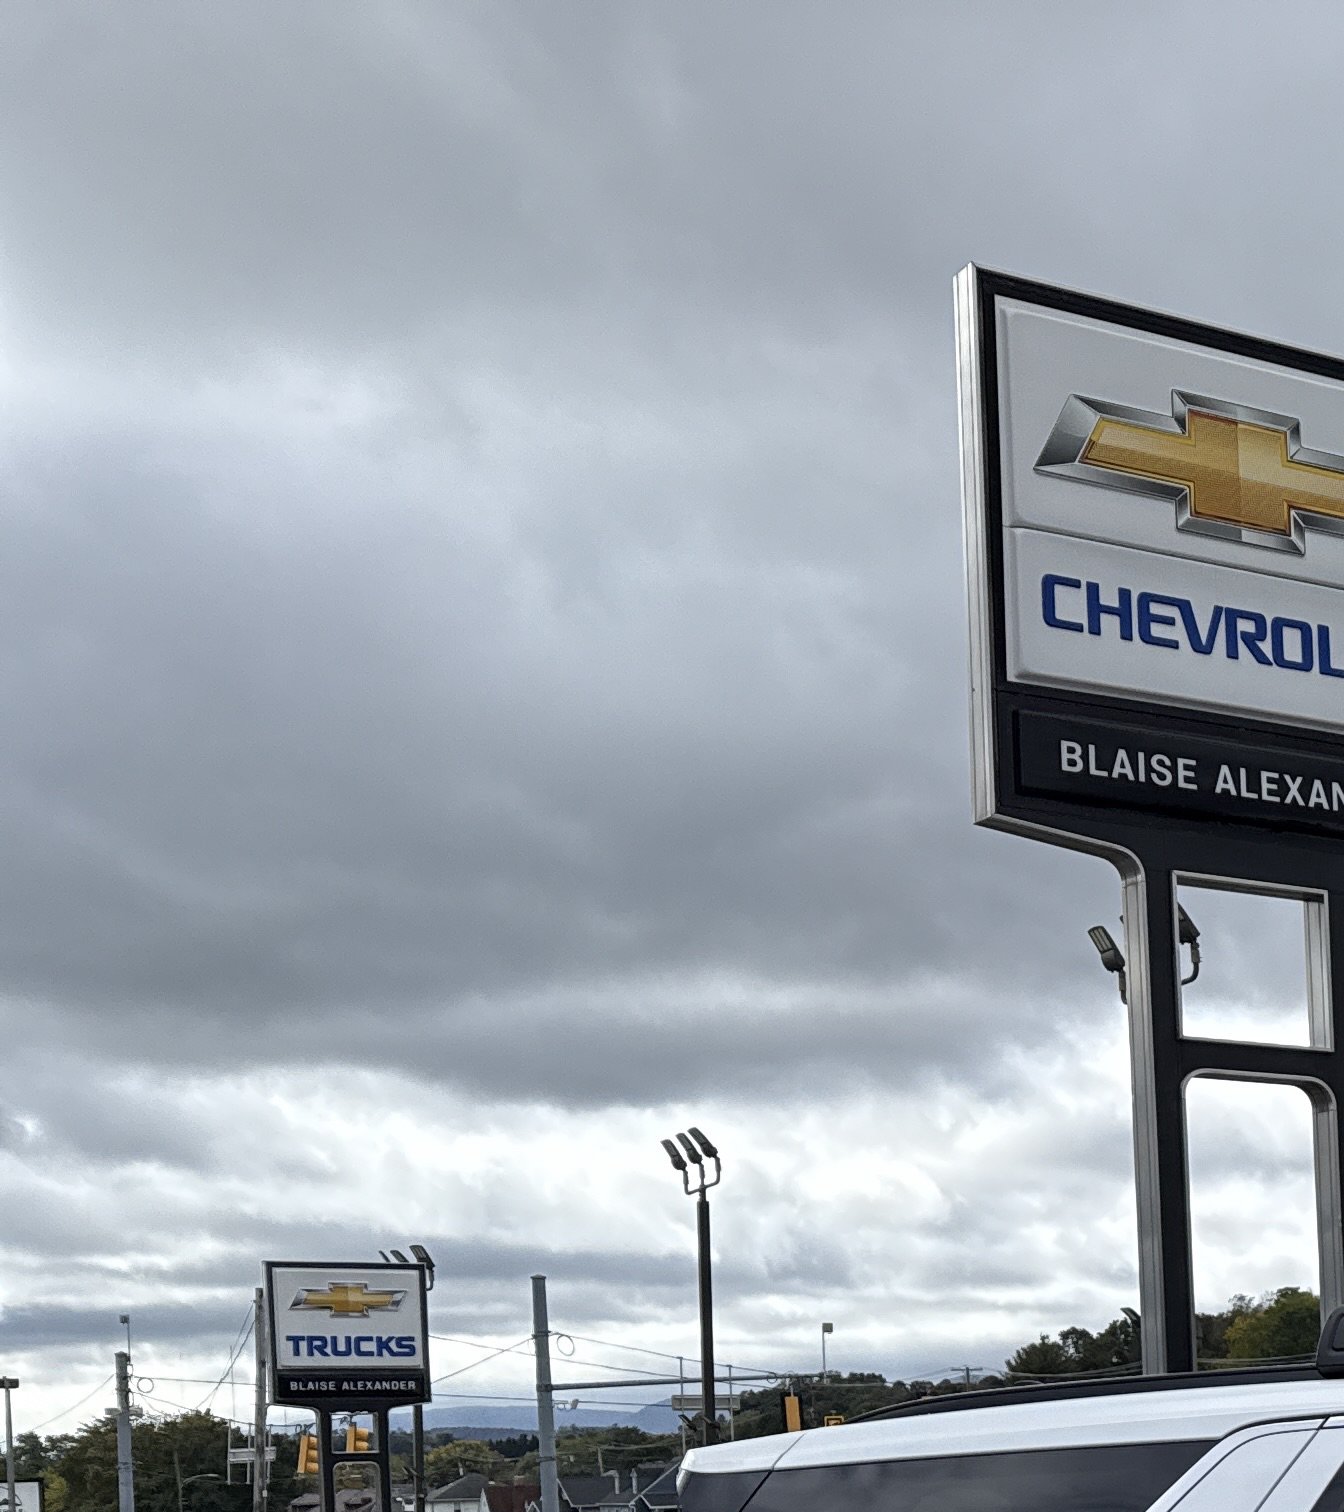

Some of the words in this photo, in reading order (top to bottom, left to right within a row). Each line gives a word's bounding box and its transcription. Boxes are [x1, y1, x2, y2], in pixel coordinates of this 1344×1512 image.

[1060, 739, 1198, 790] BLAISE
[286, 1335, 417, 1357] TRUCKS
[290, 1381, 336, 1391] BLAISE
[342, 1381, 416, 1391] ALEXANDER
